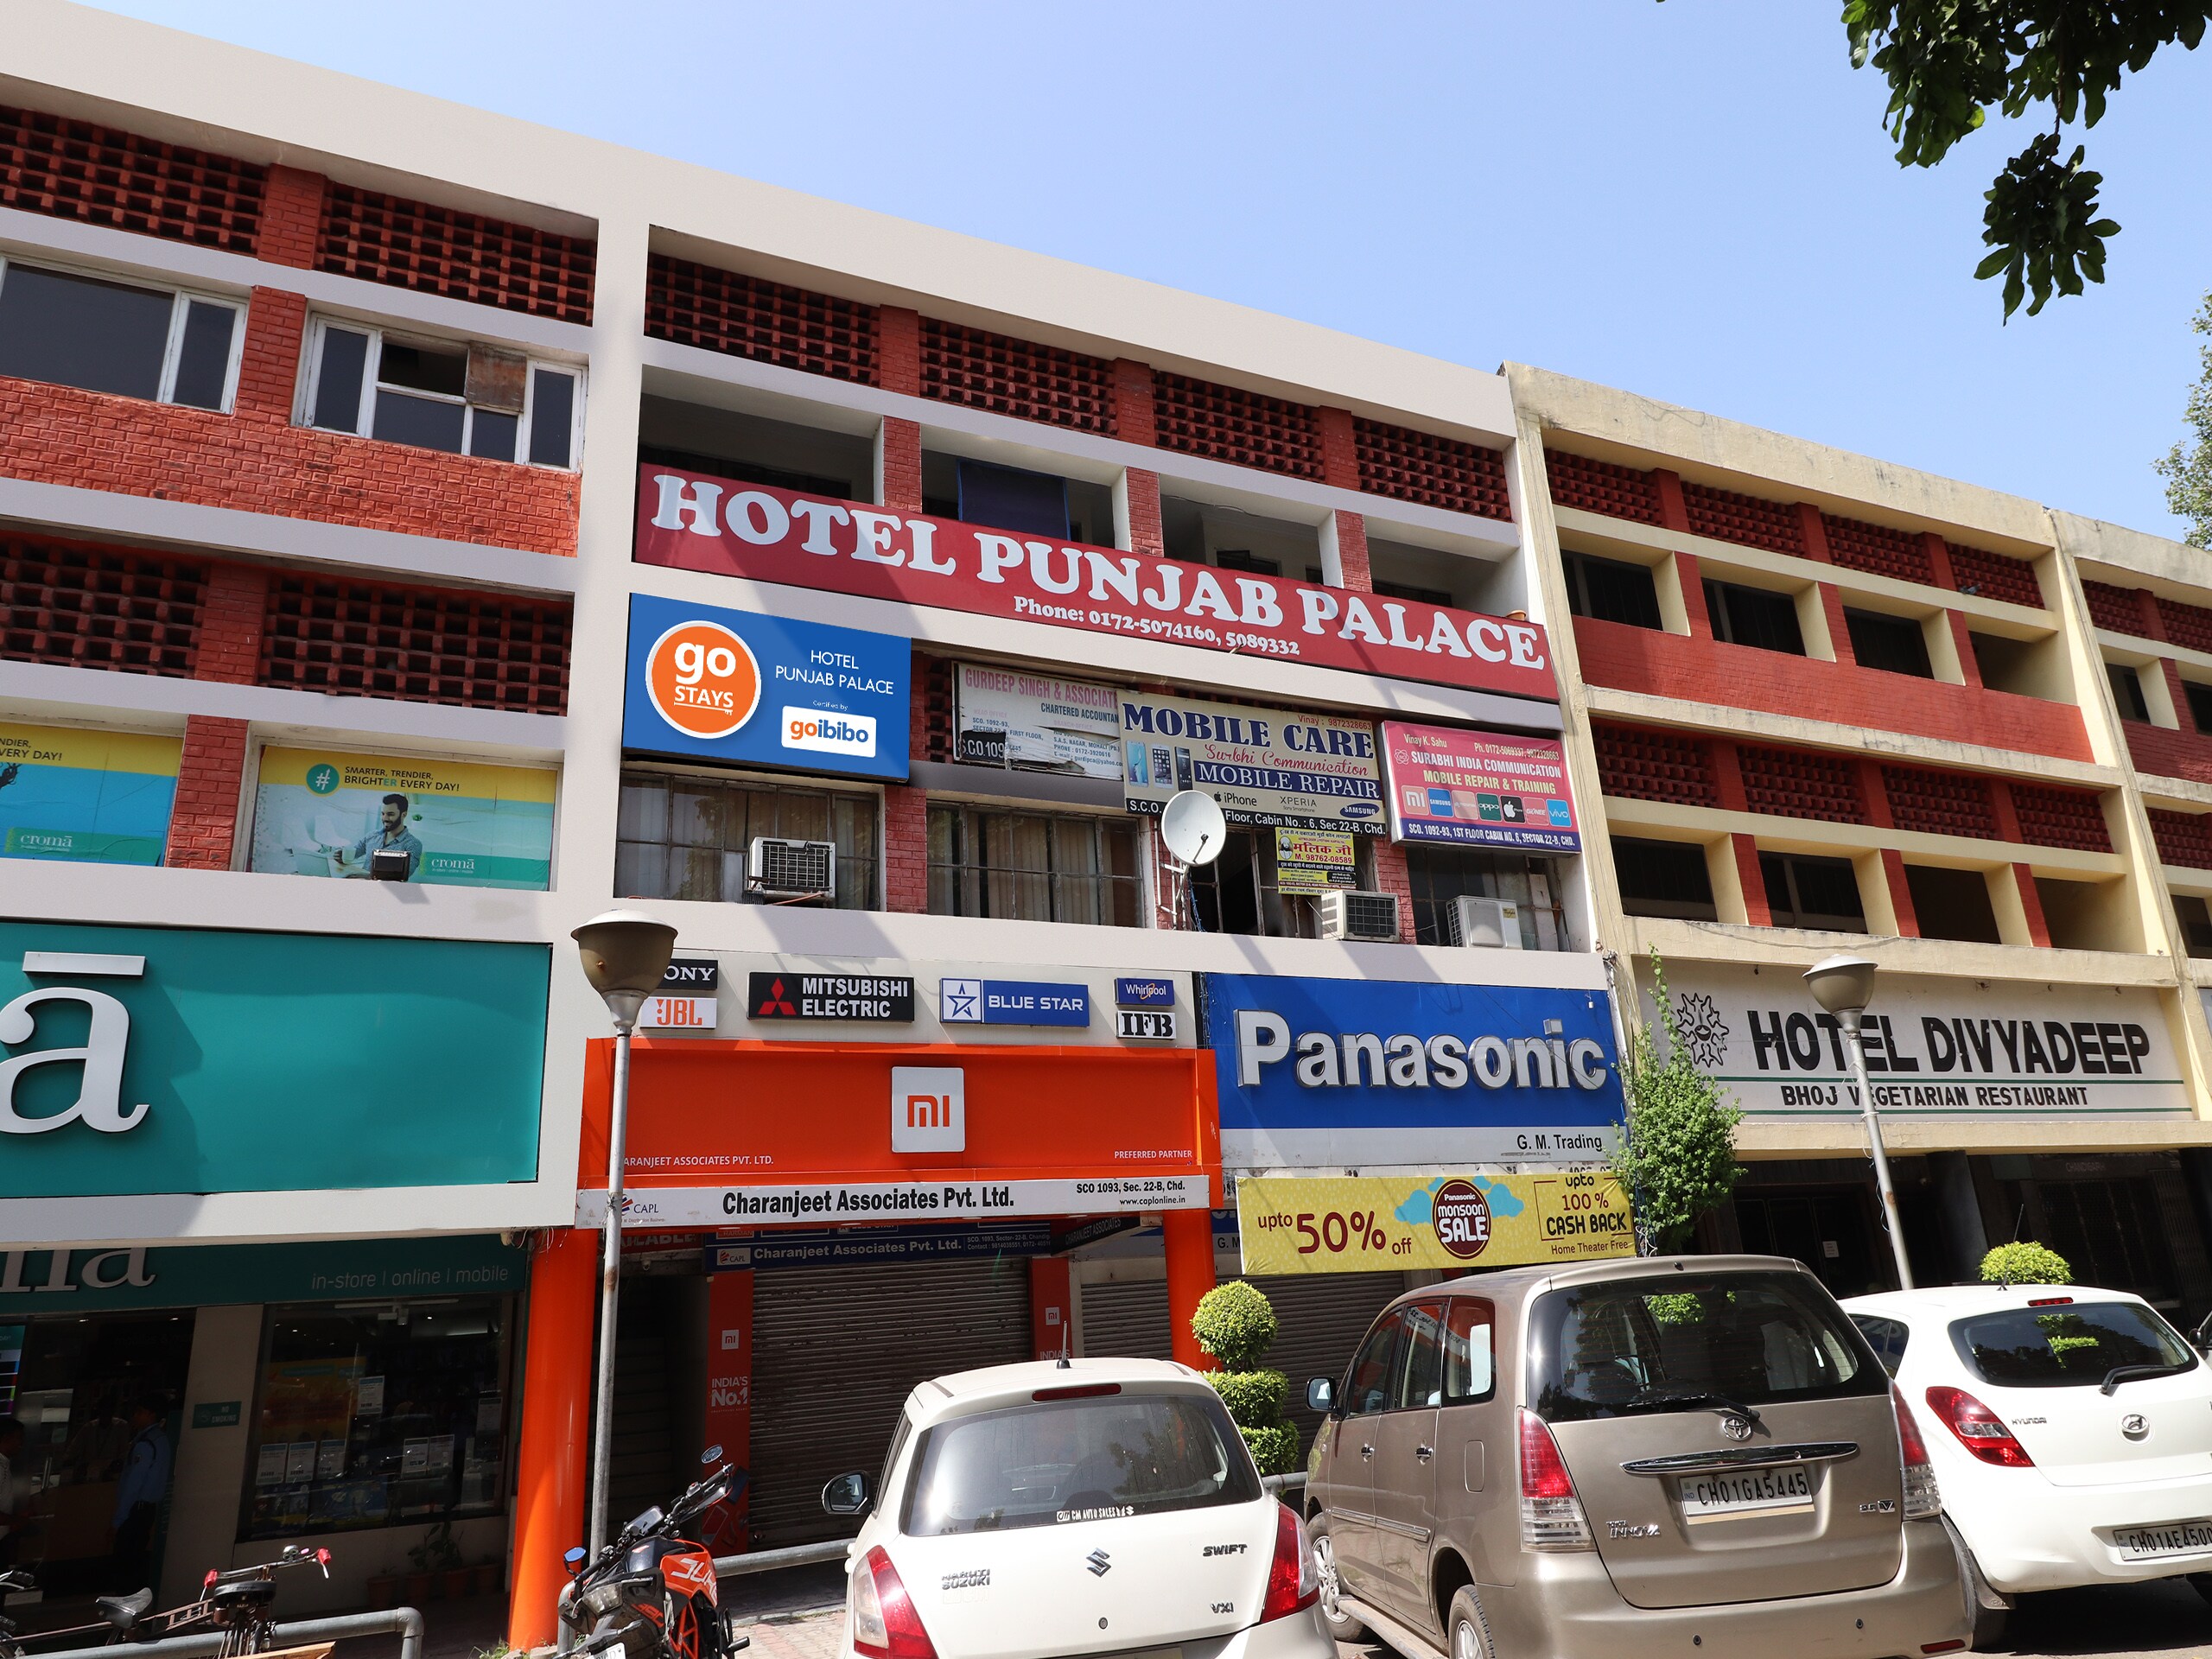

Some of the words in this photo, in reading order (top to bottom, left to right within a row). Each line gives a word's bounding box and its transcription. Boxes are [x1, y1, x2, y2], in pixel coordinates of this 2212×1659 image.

[652, 474, 957, 577] HOTEL
[973, 531, 1283, 627] PUNJAB
[1297, 588, 1546, 670] PALACE
[1014, 595, 1084, 624] Phone:
[1090, 611, 1222, 645] 0172-5074160,
[1225, 631, 1300, 656] 5089332
[674, 641, 737, 685] go
[810, 649, 860, 671] HOTEL
[775, 665, 835, 688] PUNJAB
[838, 674, 895, 696] PALACE
[965, 668, 1015, 693] GURDEEP
[1018, 676, 1051, 699] SINGH
[1053, 682, 1062, 699] &
[674, 685, 734, 709] STAYS
[1040, 702, 1079, 717] CHARTERED
[790, 719, 869, 743] goibibo
[1122, 702, 1271, 749] MOBILE
[1282, 723, 1375, 760] CARE
[1298, 714, 1320, 727] Vinay
[1327, 718, 1372, 730] 9872328663
[1403, 734, 1422, 747] Vinay
[1431, 736, 1447, 748] Sahu
[1474, 742, 1485, 753] Ph.
[33, 750, 63, 761] DAY!
[1205, 743, 1255, 765] Surbhi
[1262, 748, 1370, 777] Communication
[1411, 750, 1454, 767] SURABHI
[1456, 755, 1483, 771] INDIA
[1484, 758, 1562, 779] COMMUNICATION
[345, 766, 389, 778] SMARTER,
[391, 769, 434, 781] TRENDIER,
[1198, 763, 1294, 791] MOBILE
[1299, 774, 1380, 798] REPAIR
[1423, 770, 1463, 785] MOBILE
[1464, 774, 1501, 790] REPAIR
[1502, 778, 1511, 791] &
[1511, 779, 1557, 795] TRAINING
[344, 775, 397, 787] BRIGHTER
[400, 779, 433, 790] EVERY
[435, 781, 461, 792] DAY!
[1224, 791, 1258, 807] iPhone
[1280, 796, 1318, 807] XPERIA
[1429, 798, 1452, 807] SAMSUNG
[1129, 800, 1163, 813] S.C.O.
[1225, 810, 1254, 824] Floor,
[1255, 812, 1283, 827] Cabin
[1285, 816, 1301, 827] No.
[1319, 820, 1338, 830] Sec
[1339, 821, 1363, 835] 22-B,
[1365, 823, 1386, 835] Chd.
[1344, 805, 1376, 815] SAMSUNG
[1408, 823, 1424, 835] SCO.
[1465, 828, 1484, 840] FLOOR
[1484, 830, 1504, 841] CABIN
[1503, 831, 1515, 842] NO.
[1522, 832, 1545, 844] SECTOR
[1560, 836, 1575, 846] CHD.
[1306, 854, 1352, 864] 98762-08589
[664, 965, 715, 982] ONY
[802, 977, 908, 997] MITSUBISHI
[1125, 982, 1167, 1000] Whirlpool
[657, 999, 703, 1027] JBL
[802, 999, 892, 1018] ELECTRIC
[988, 995, 1034, 1009] BLUE
[1039, 997, 1084, 1012] STAR
[1122, 1013, 1173, 1037] IFB
[1233, 1007, 1608, 1091] Panasonic
[1747, 1008, 1920, 1073] HOTEL
[1921, 1015, 2151, 1075] DIVYADEEP
[1781, 1084, 1840, 1108] BHOJ
[1847, 1085, 1970, 1107] VGETARIAN
[1975, 1085, 2088, 1107] RESTAURANT
[1516, 1135, 1532, 1150] G.
[1535, 1134, 1551, 1150] M.
[1553, 1134, 1603, 1152] Trading
[609, 1156, 672, 1168] ARANJEET
[673, 1156, 731, 1166] ASSOCIATES
[732, 1155, 752, 1166] PVT.
[753, 1155, 774, 1165] LTD.
[1114, 1150, 1157, 1160] PREFERRED
[1158, 1149, 1193, 1159] PARTNER
[1076, 1182, 1095, 1194] SCO
[1096, 1181, 1122, 1196] 1093,
[1122, 1181, 1141, 1192] Sec.
[1143, 1181, 1166, 1194] 22-B,
[1166, 1180, 1185, 1192] Chd.
[1566, 1173, 1595, 1190] upto
[722, 1190, 832, 1217] Charanjeet
[835, 1188, 939, 1213] Associates
[943, 1187, 977, 1208] Pvt.
[982, 1186, 1014, 1207] Ltd.
[1119, 1195, 1185, 1207] www.caplonline.in
[1444, 1192, 1477, 1201] Panasonic
[1561, 1192, 1592, 1211] 100
[1594, 1192, 1609, 1209] %
[633, 1203, 660, 1214] CAPL
[1257, 1212, 1294, 1230] upto
[1296, 1210, 1387, 1255] 50%
[1391, 1236, 1413, 1255] off
[1439, 1216, 1490, 1243] SALE
[1546, 1215, 1586, 1236] CASH
[1589, 1211, 1627, 1231] BACK
[753, 1244, 830, 1261] Charanjeet
[833, 1242, 906, 1256] Associates
[909, 1241, 934, 1252] Pvt.
[938, 1240, 962, 1250] Ltd.
[1551, 1243, 1576, 1255] Home
[1577, 1241, 1609, 1254] Theater
[1610, 1240, 1629, 1251] Free
[311, 1271, 378, 1293] in-store
[391, 1268, 442, 1290] online
[455, 1266, 509, 1287] mobile
[711, 1376, 748, 1389] INDIA'S
[710, 1386, 748, 1408] No.1
[2012, 1416, 2048, 1426] HYUNDAI
[1696, 1471, 1808, 1507] CH01GA5445
[1202, 1543, 1248, 1557] SWIFT
[941, 1576, 990, 1591] SUZUKI
